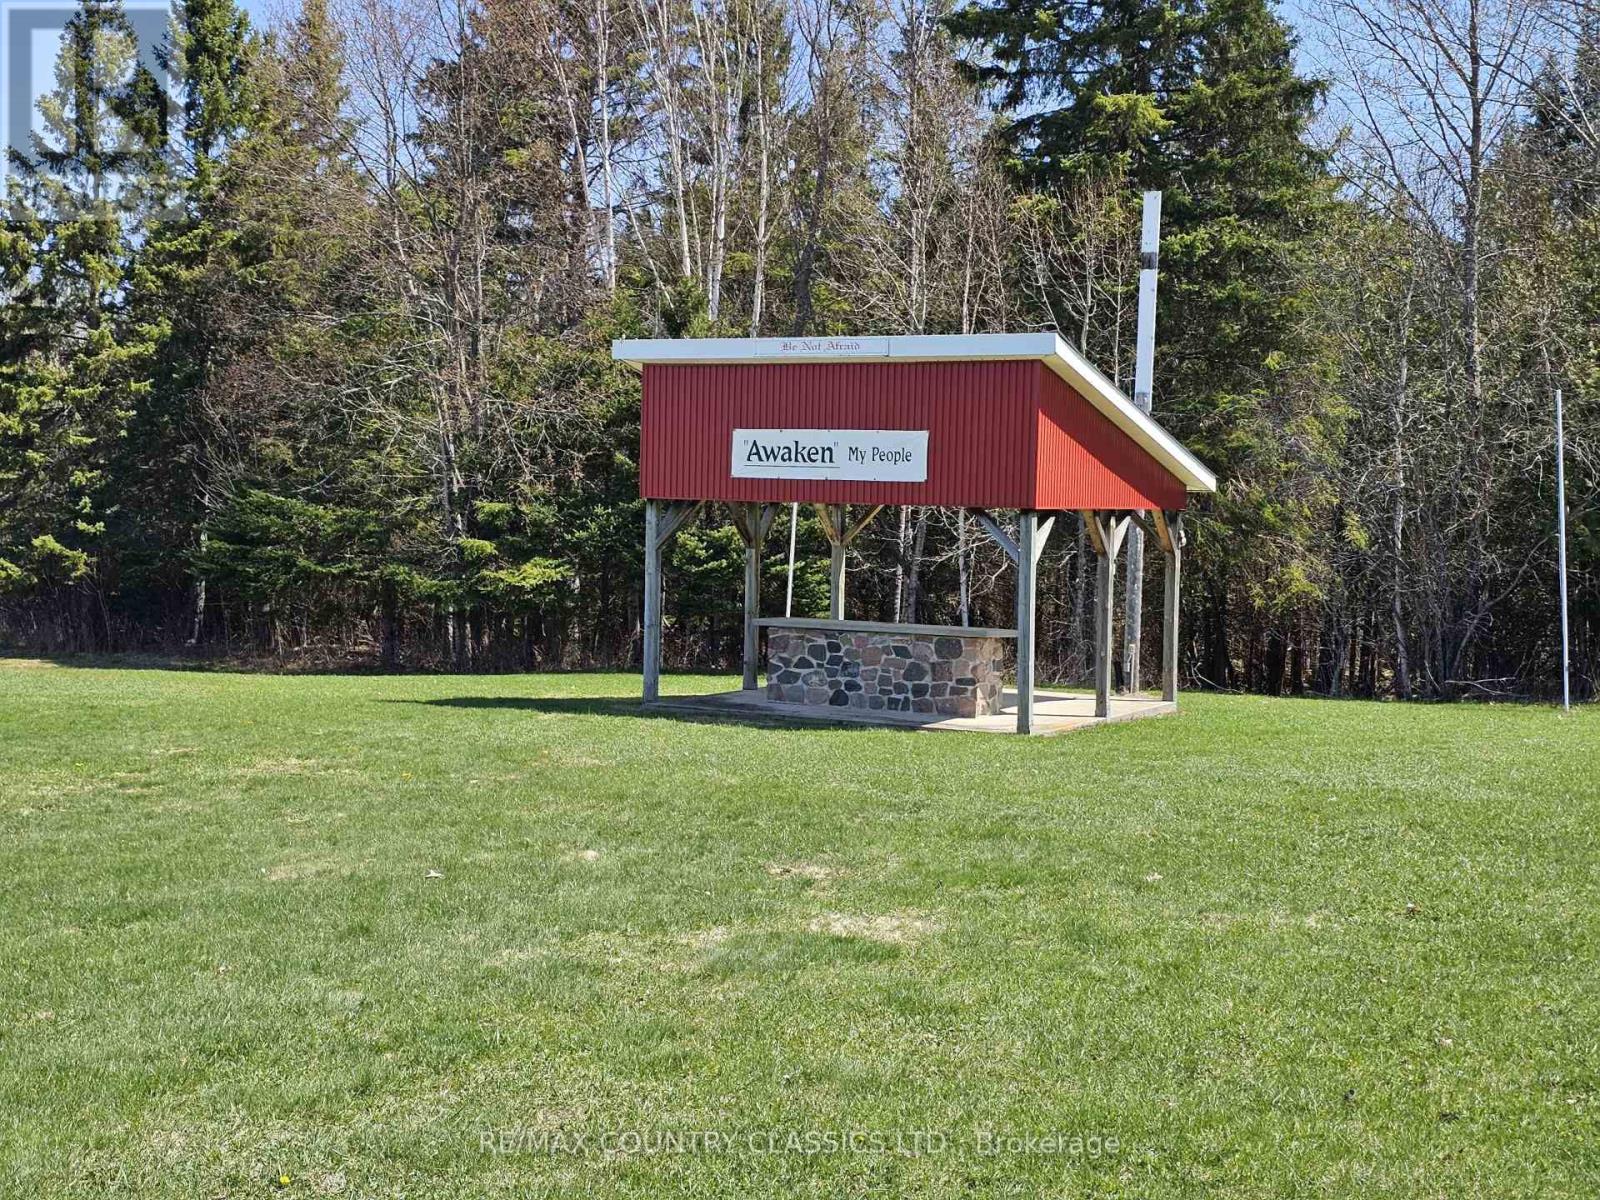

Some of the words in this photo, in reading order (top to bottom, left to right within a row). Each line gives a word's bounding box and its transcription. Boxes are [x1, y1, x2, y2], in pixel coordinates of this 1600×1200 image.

[780, 341, 798, 352] Be
[800, 341, 821, 352] Not
[824, 341, 860, 353] Afraid
[743, 439, 839, 464] "Awaken"
[848, 446, 867, 465] My
[872, 446, 912, 465] People
